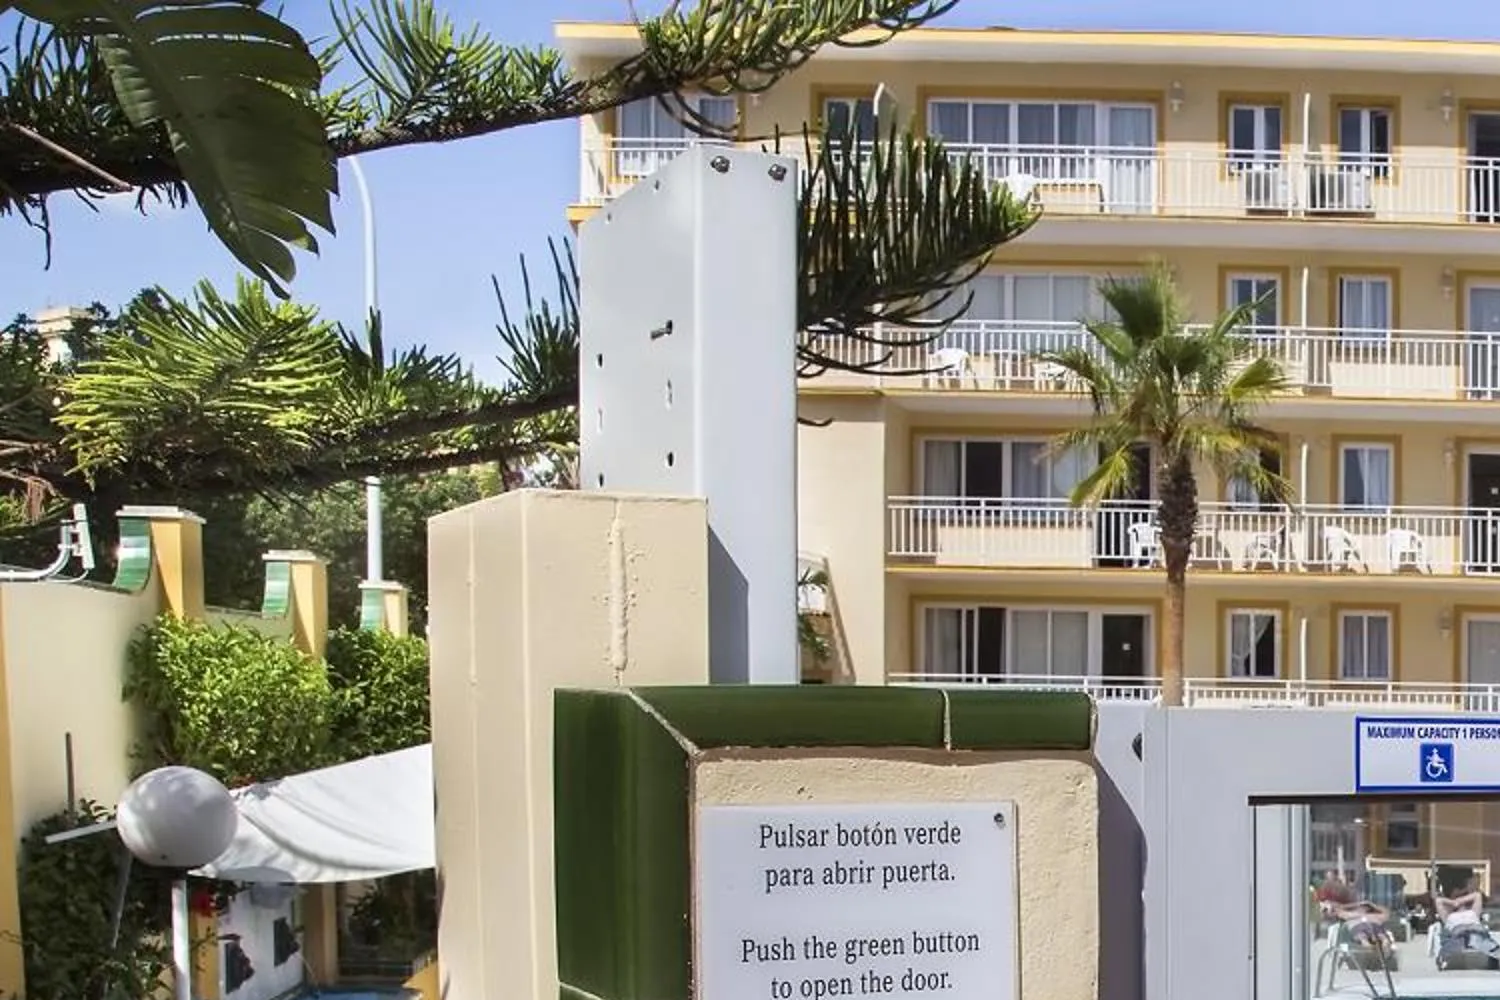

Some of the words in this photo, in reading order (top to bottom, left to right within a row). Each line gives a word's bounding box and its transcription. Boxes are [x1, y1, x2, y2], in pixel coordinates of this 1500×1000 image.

[1417, 727, 1460, 738] CAPACITY
[1462, 728, 1467, 738] 1
[760, 824, 829, 848] Pulsar
[835, 821, 897, 846] botón
[904, 820, 960, 845] verde
[765, 868, 814, 894] para
[822, 860, 875, 885] abrir
[883, 860, 955, 890] puerta.
[742, 936, 796, 963] Push
[804, 936, 837, 960] the
[845, 938, 905, 964] green
[912, 931, 979, 954] button
[771, 978, 792, 999] to
[860, 970, 893, 994] the
[901, 968, 952, 992] door.
